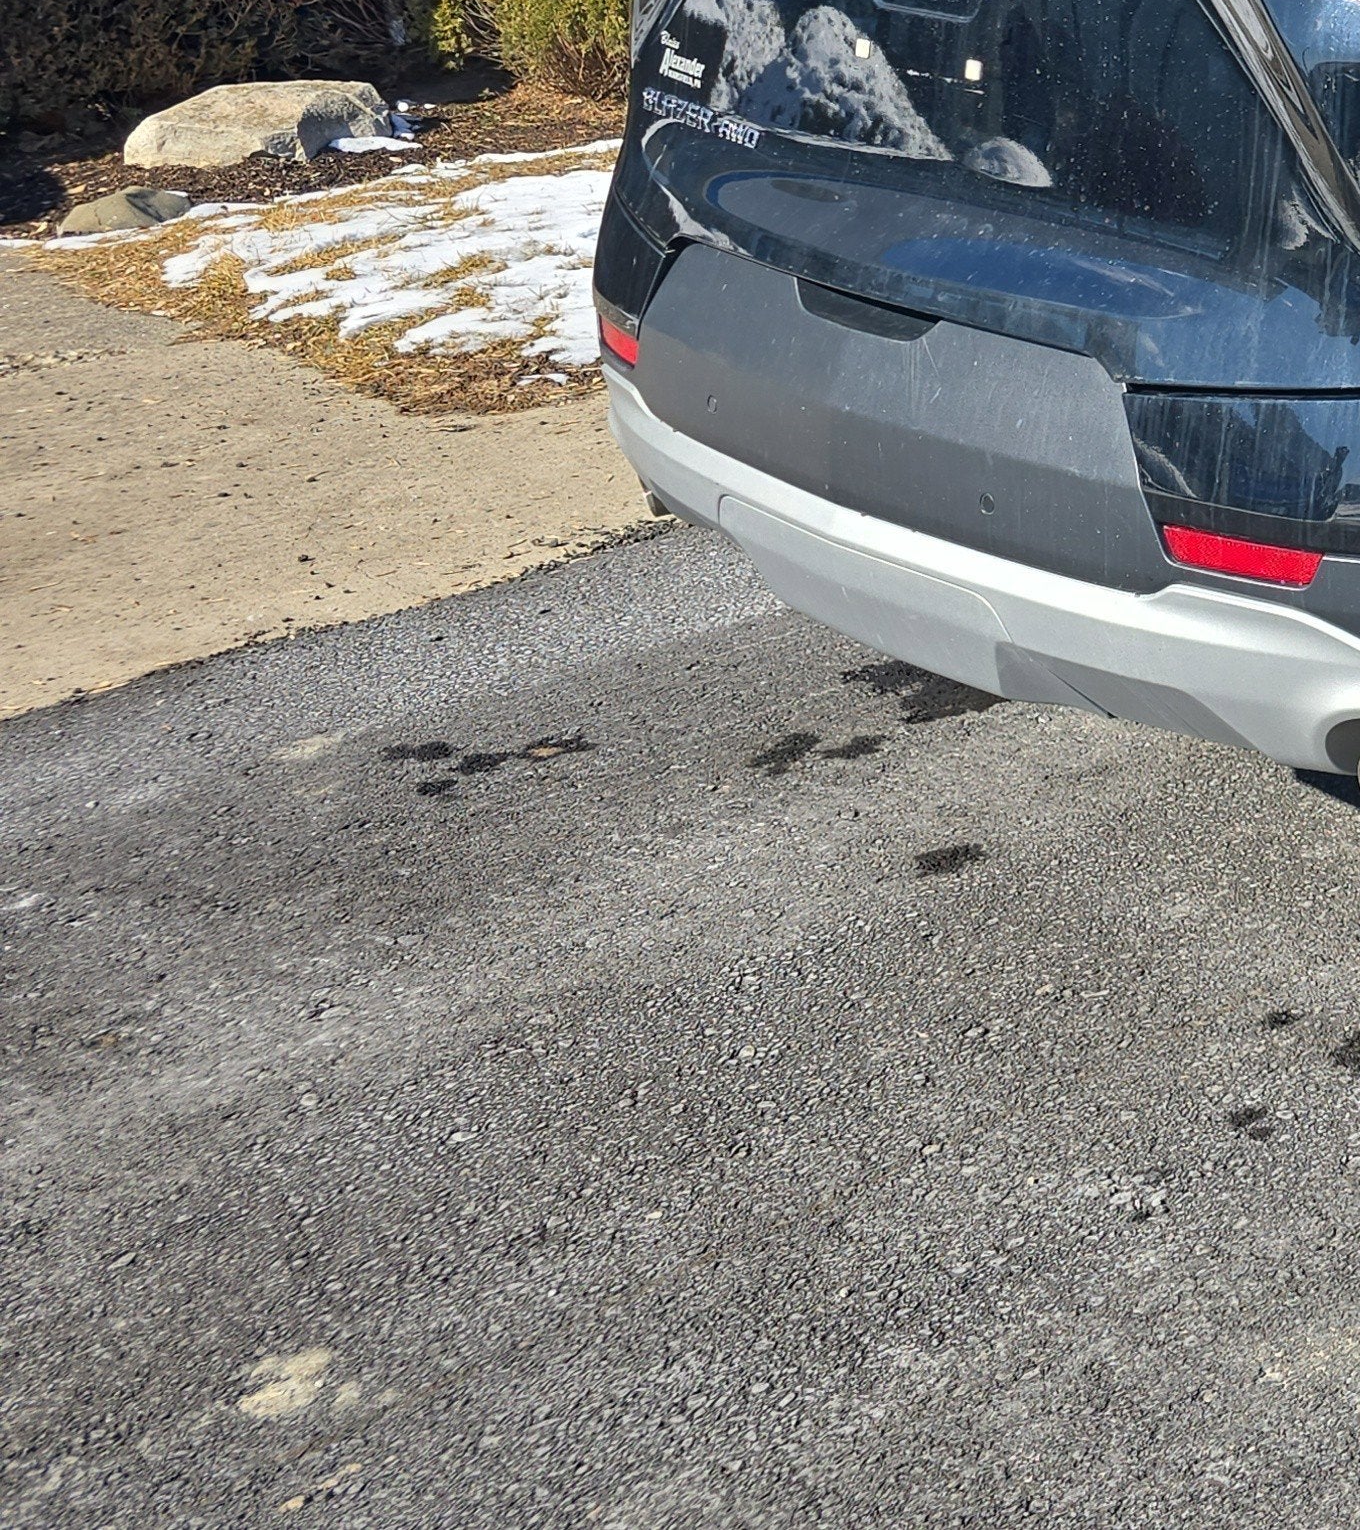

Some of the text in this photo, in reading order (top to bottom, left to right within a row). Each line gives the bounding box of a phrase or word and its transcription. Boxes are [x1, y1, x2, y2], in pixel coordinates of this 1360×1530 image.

[659, 47, 706, 78] Alexander
[642, 86, 760, 149] BLAZER AWD
